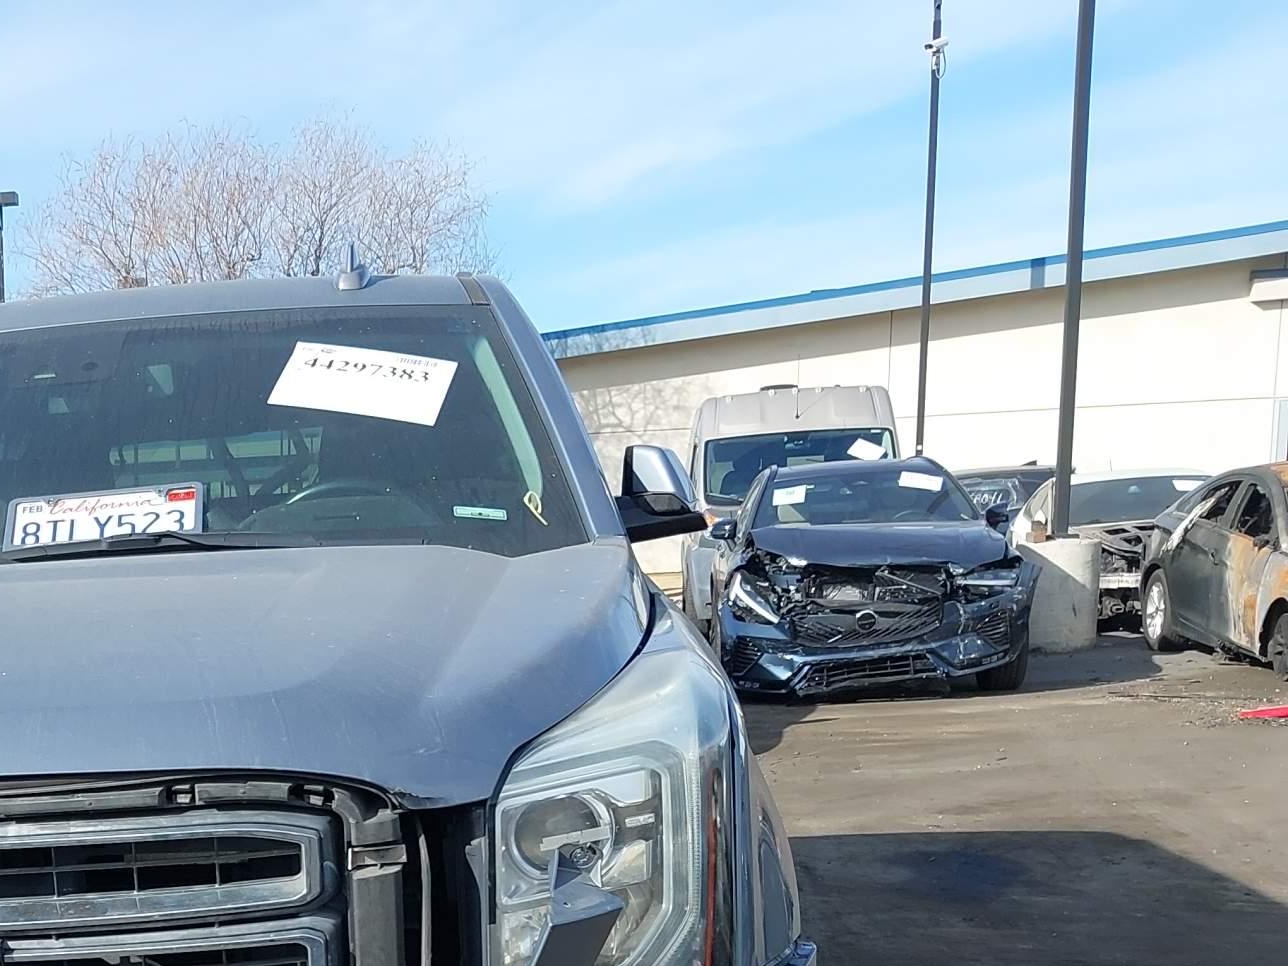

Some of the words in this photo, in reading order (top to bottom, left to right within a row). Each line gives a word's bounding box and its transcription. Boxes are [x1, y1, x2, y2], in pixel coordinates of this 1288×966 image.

[304, 357, 430, 382] 44297383
[22, 503, 43, 515] FEB
[49, 496, 162, 516] California
